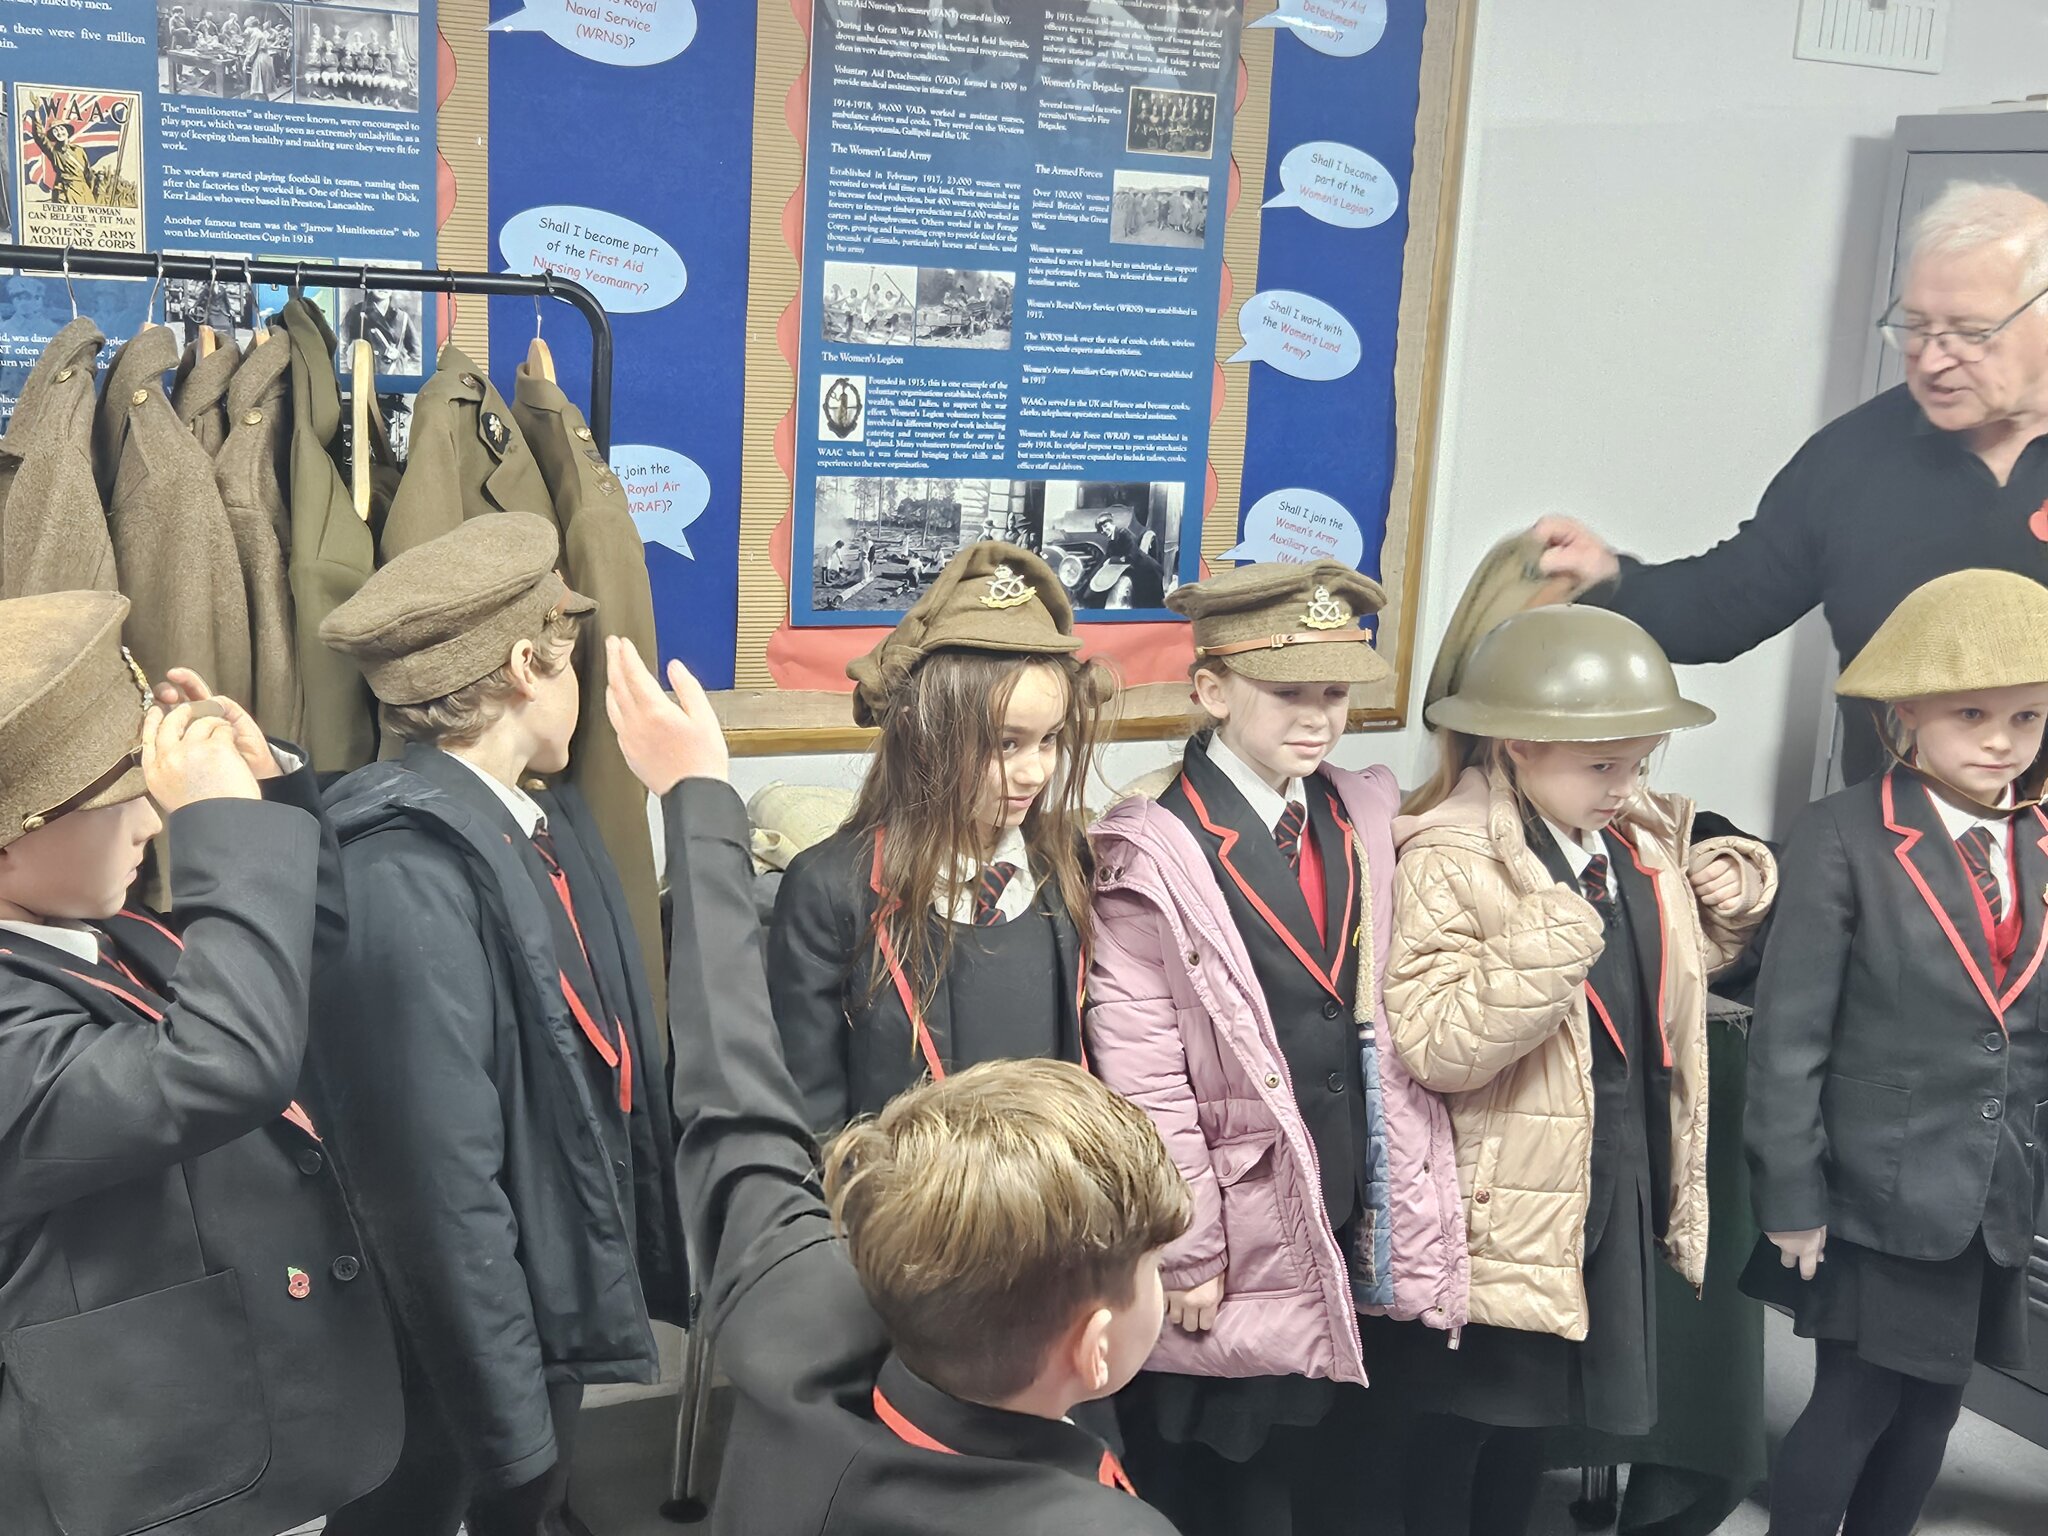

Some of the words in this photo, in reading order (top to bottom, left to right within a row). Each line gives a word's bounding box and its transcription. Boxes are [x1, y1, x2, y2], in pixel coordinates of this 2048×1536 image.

[565, 1, 600, 19] Naval
[604, 10, 651, 32] Service
[14, 23, 43, 36] there
[48, 28, 76, 38] were
[80, 28, 101, 40] five
[106, 32, 146, 45] million
[576, 24, 635, 49] (WRNS)?
[1040, 74, 1075, 87] Women's
[1075, 78, 1091, 89] Fire
[1092, 80, 1124, 93] Brigades
[831, 143, 848, 154] The
[849, 144, 885, 156] Women's
[886, 147, 907, 158] Land
[907, 149, 931, 162] Army
[1035, 164, 1050, 174] The
[1050, 165, 1078, 176] Armed
[1078, 167, 1103, 178] Forces
[1311, 154, 1334, 168] Shall
[1336, 162, 1342, 170] I
[1344, 164, 1378, 184] become
[1315, 174, 1334, 187] part
[1337, 180, 1348, 190] of
[1351, 184, 1366, 197] the
[42, 204, 68, 212] EVERY
[88, 206, 120, 216] WOMAN
[1300, 184, 1338, 206] Women's
[1341, 196, 1374, 217] Legion?
[28, 212, 46, 220] CAN
[50, 213, 88, 222] RELEASE
[100, 216, 112, 224] FIT
[116, 217, 136, 225] MAN
[30, 225, 94, 237] WOMEN'S
[100, 230, 136, 240] ARMY
[538, 217, 569, 235] Shall
[573, 225, 580, 237] I
[585, 228, 629, 250] become
[633, 242, 659, 258] part
[98, 239, 136, 249] CORPS
[547, 240, 561, 252] of
[565, 243, 586, 259] the
[589, 248, 620, 267] First
[623, 258, 644, 273] Aid
[533, 255, 580, 281] Nursing
[586, 267, 649, 295] Yeomanry?
[1270, 300, 1292, 316] Shall
[1294, 309, 1300, 320] I
[1300, 314, 1322, 328] work
[1324, 321, 1342, 337] with
[1262, 316, 1278, 330] the
[1280, 322, 1318, 344] Women's
[1319, 338, 1341, 353] Land
[15, 346, 39, 354] often
[821, 351, 838, 361] The
[839, 352, 876, 363] Women's
[876, 354, 903, 366] Legion
[1282, 342, 1310, 360] Army?
[19, 359, 36, 368] yell
[614, 466, 620, 477] I
[624, 465, 646, 480] join
[650, 463, 670, 474] the
[627, 482, 658, 497] Royal
[663, 482, 680, 492] Air
[1278, 501, 1300, 516] Shall
[1302, 508, 1308, 518] I
[1309, 514, 1326, 524] join
[1330, 518, 1344, 530] the
[1276, 516, 1314, 537] Women's
[1315, 531, 1338, 548] Army
[1269, 533, 1308, 554] Auxiliary
